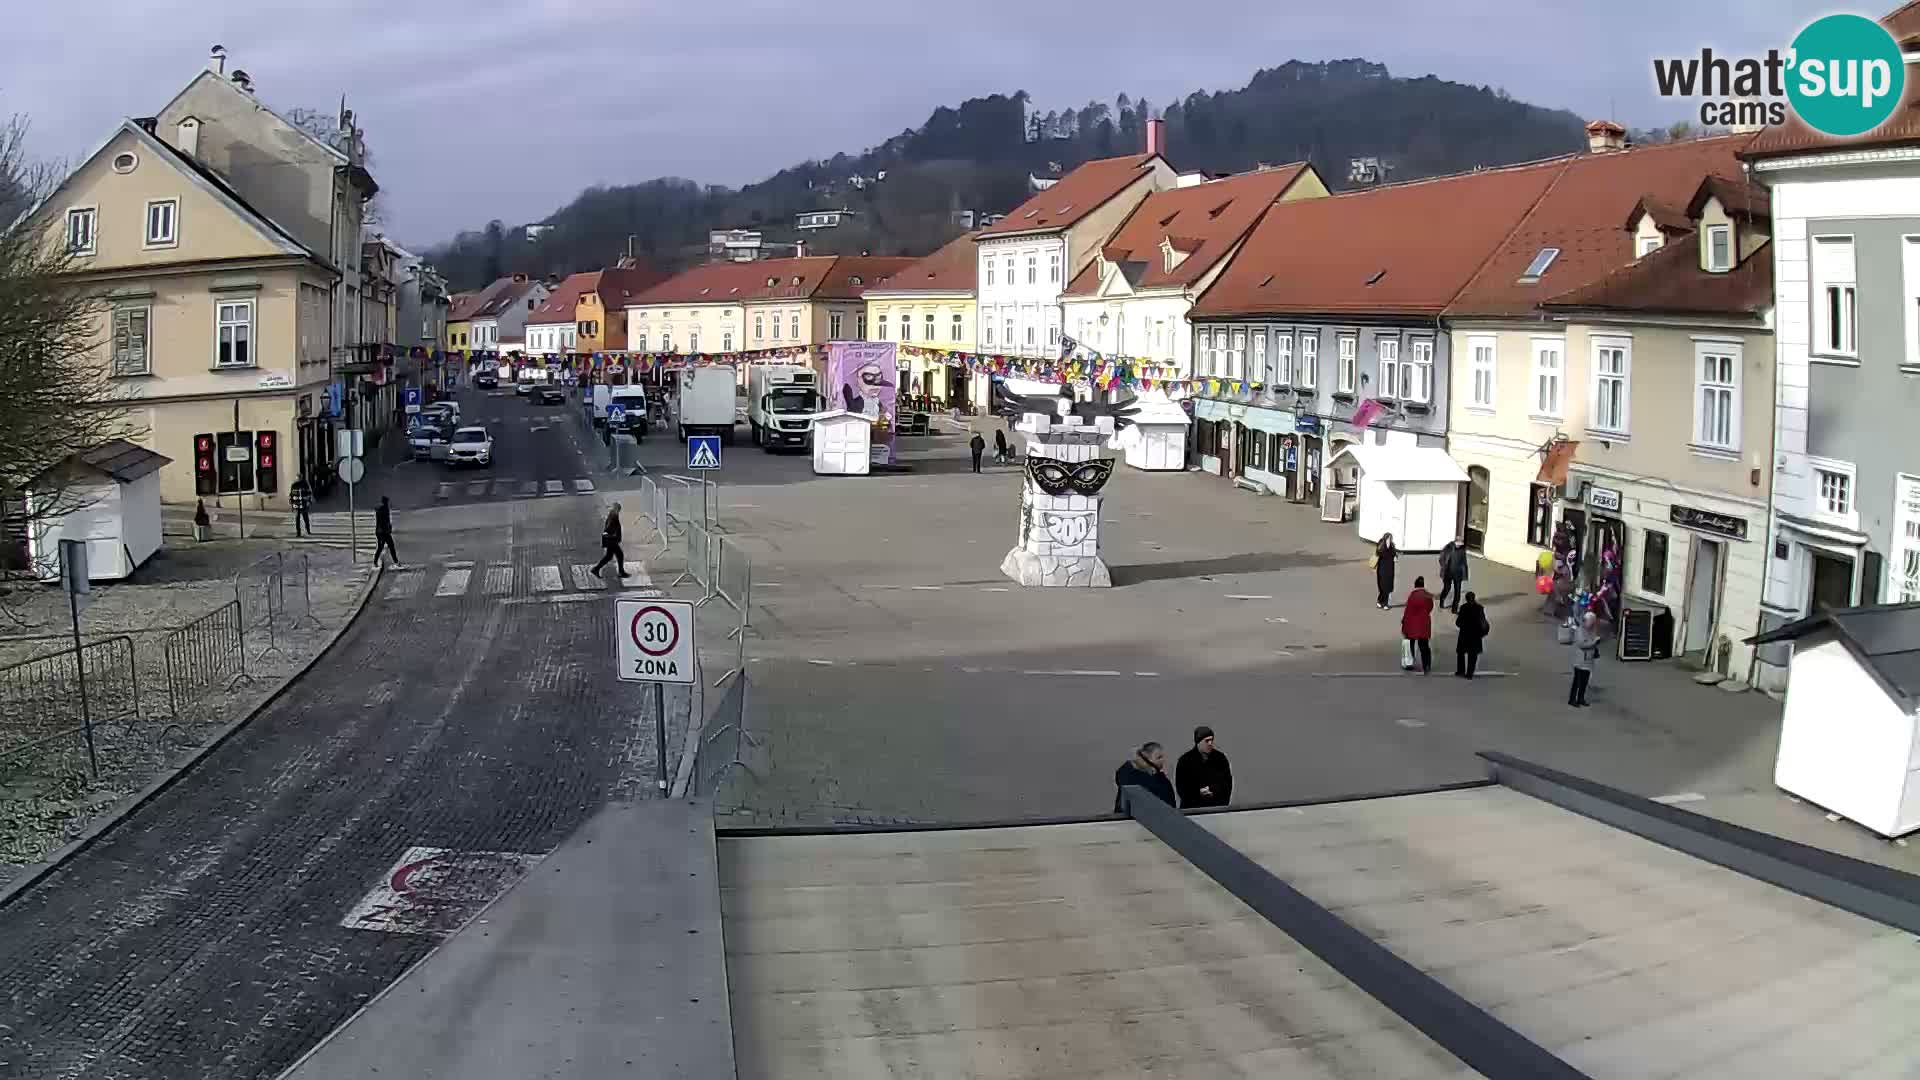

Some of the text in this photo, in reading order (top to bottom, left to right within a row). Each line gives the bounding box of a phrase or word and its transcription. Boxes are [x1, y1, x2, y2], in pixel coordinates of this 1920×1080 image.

[408, 391, 417, 403] P
[1048, 516, 1088, 544] 200
[644, 621, 668, 642] 30
[634, 659, 678, 676] ZONA
